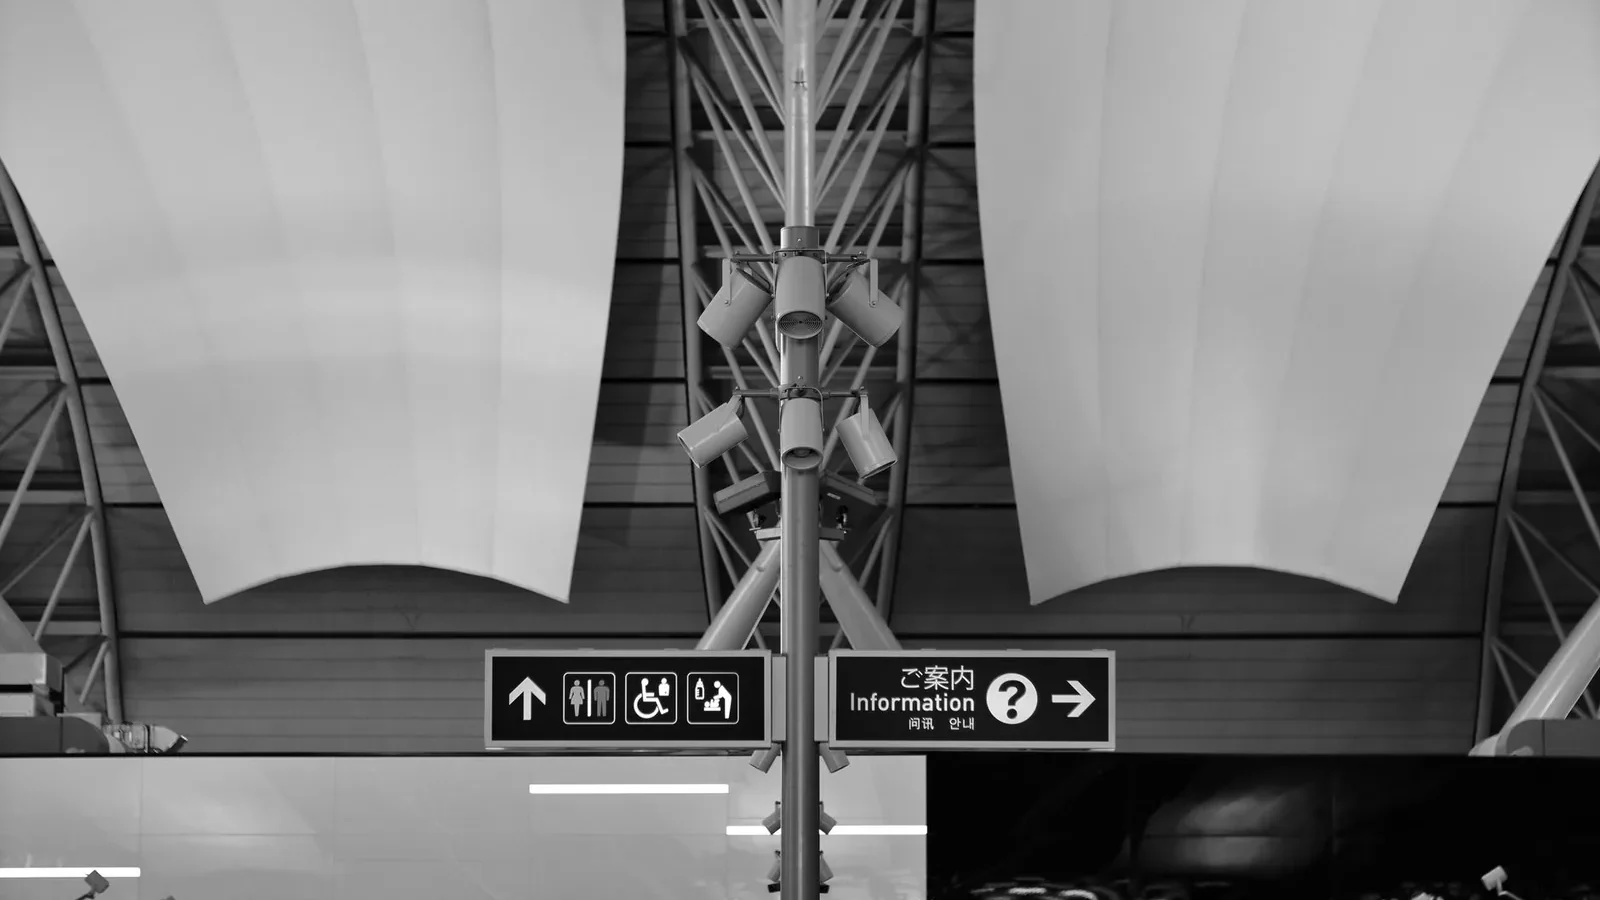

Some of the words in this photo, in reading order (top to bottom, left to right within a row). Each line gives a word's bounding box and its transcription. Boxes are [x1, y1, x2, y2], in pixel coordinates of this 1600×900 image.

[900, 665, 974, 691] ご案内
[850, 692, 975, 712] Information
[909, 717, 935, 731] 问讯
[948, 717, 975, 731] 안내
